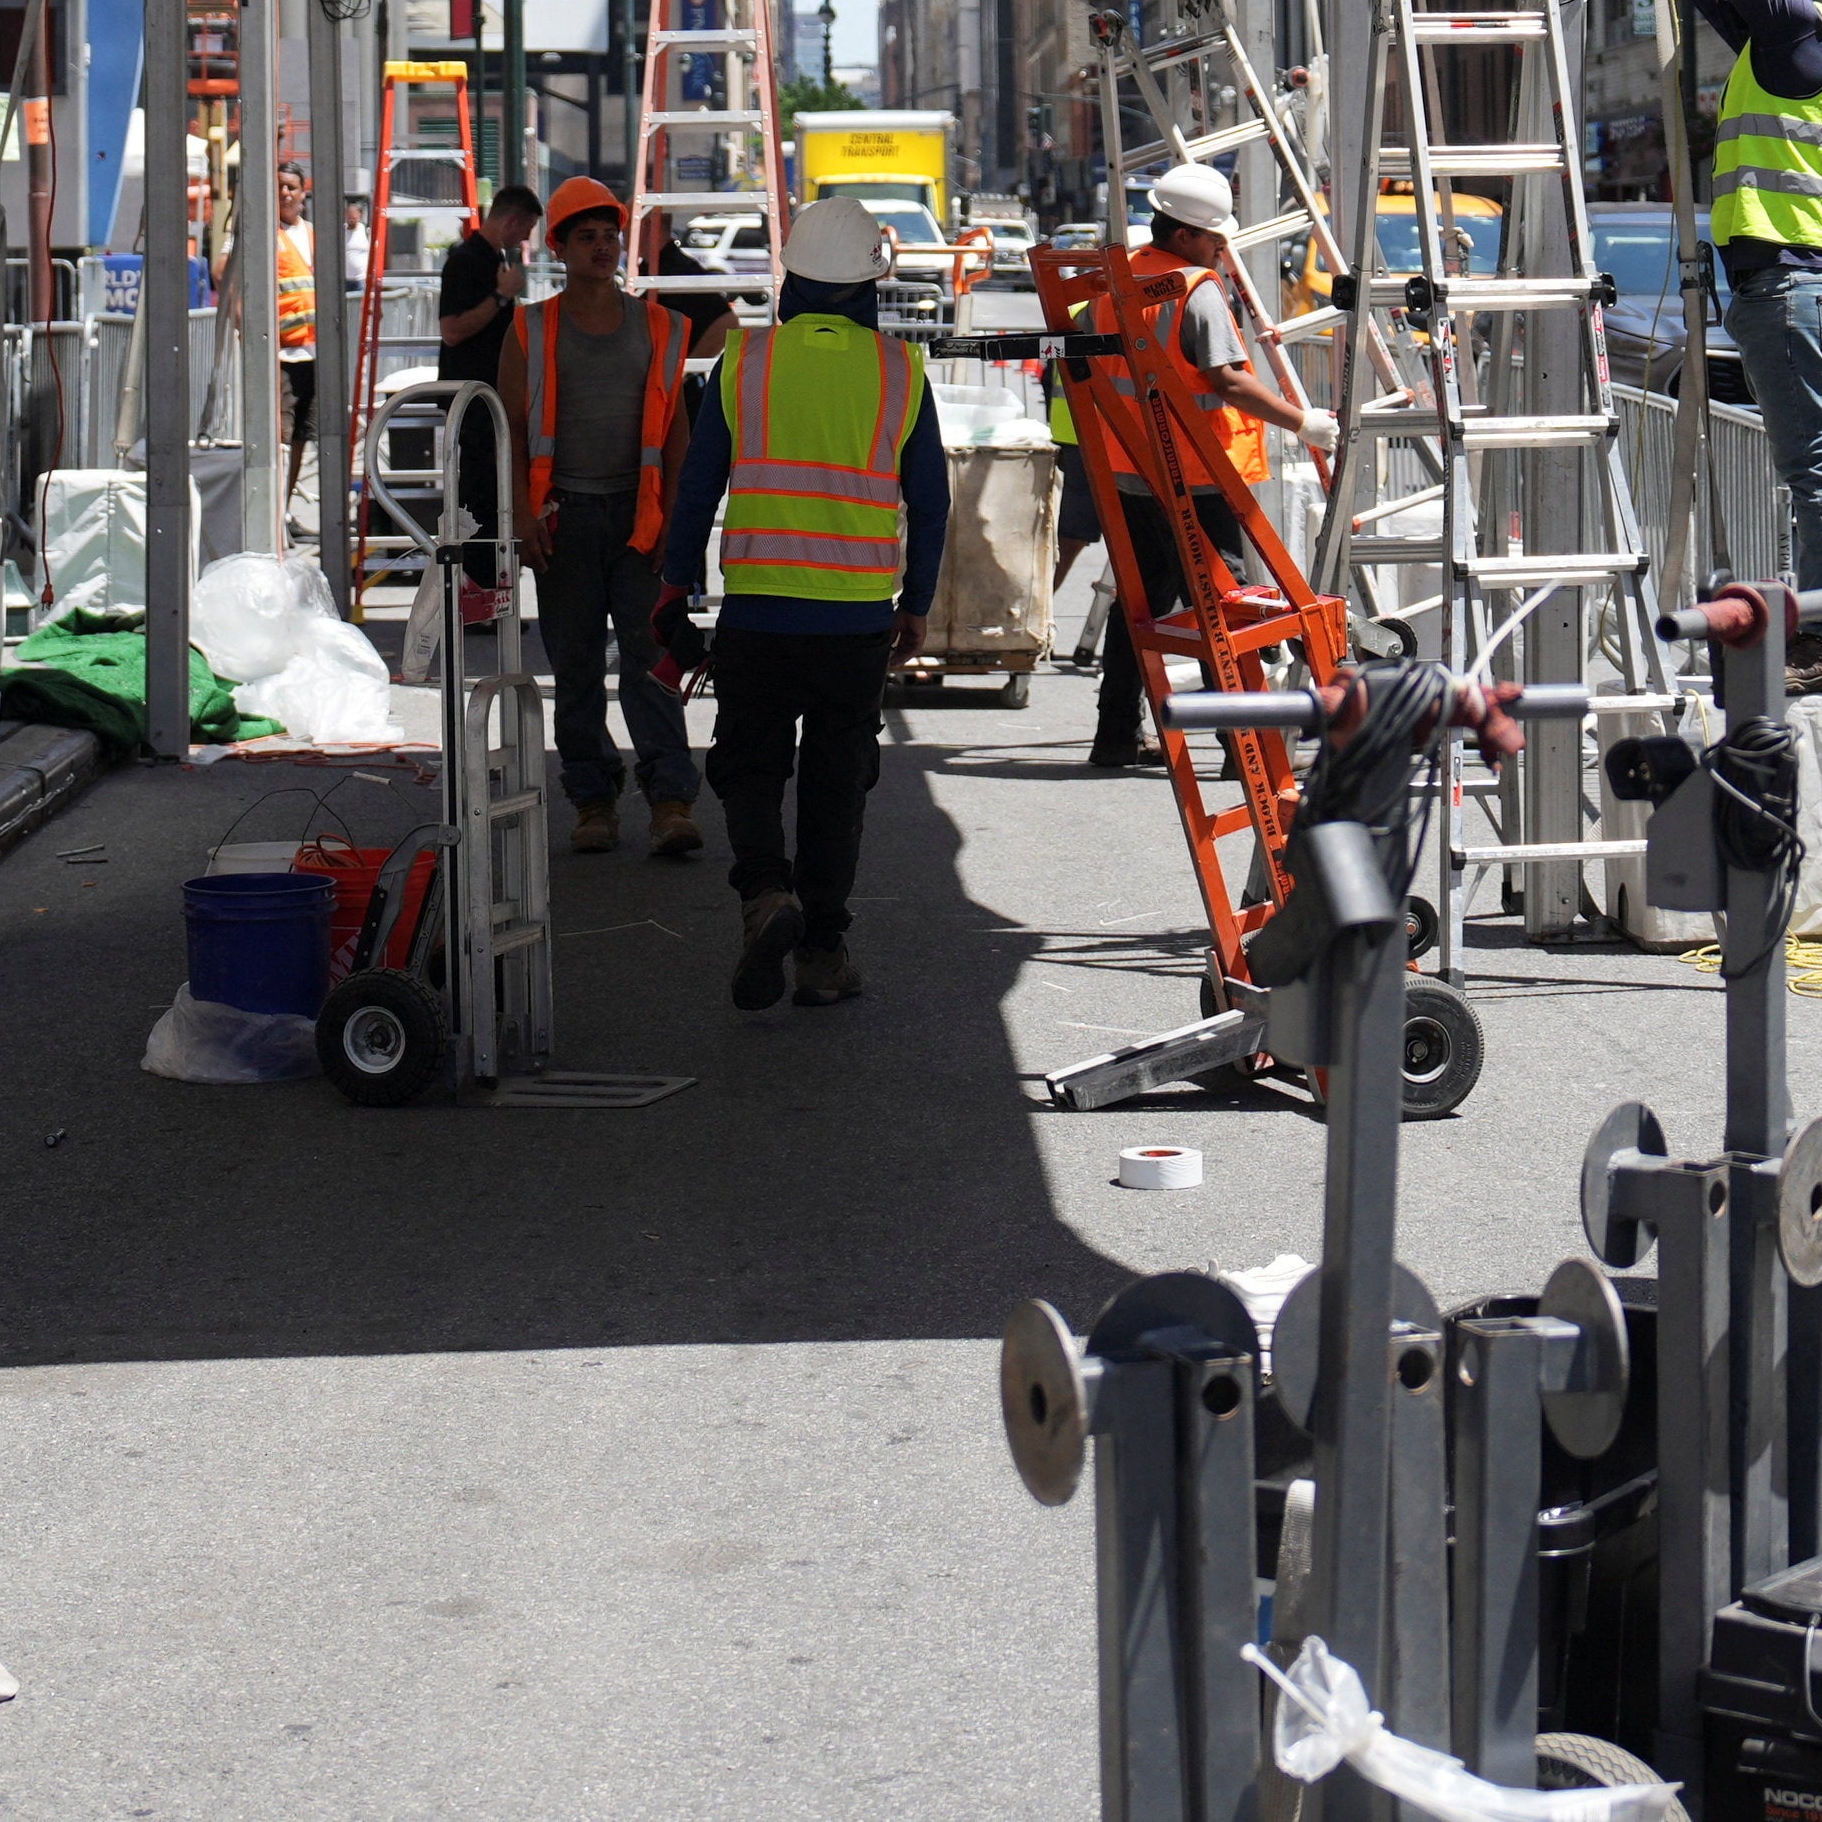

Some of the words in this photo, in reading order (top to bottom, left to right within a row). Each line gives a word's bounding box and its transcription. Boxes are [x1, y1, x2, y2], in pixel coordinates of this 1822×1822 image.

[842, 145, 900, 157] TRANSPORT
[850, 133, 895, 145] CENTRAL
[1143, 277, 1175, 295] BLOCK
[1152, 284, 1177, 298] ROLL
[1181, 507, 1205, 572] MOVER
[1196, 573, 1226, 645] BALLAST
[1217, 648, 1239, 693] TENT
[1245, 742, 1262, 776] AND
[1255, 781, 1278, 838] BLOCK
